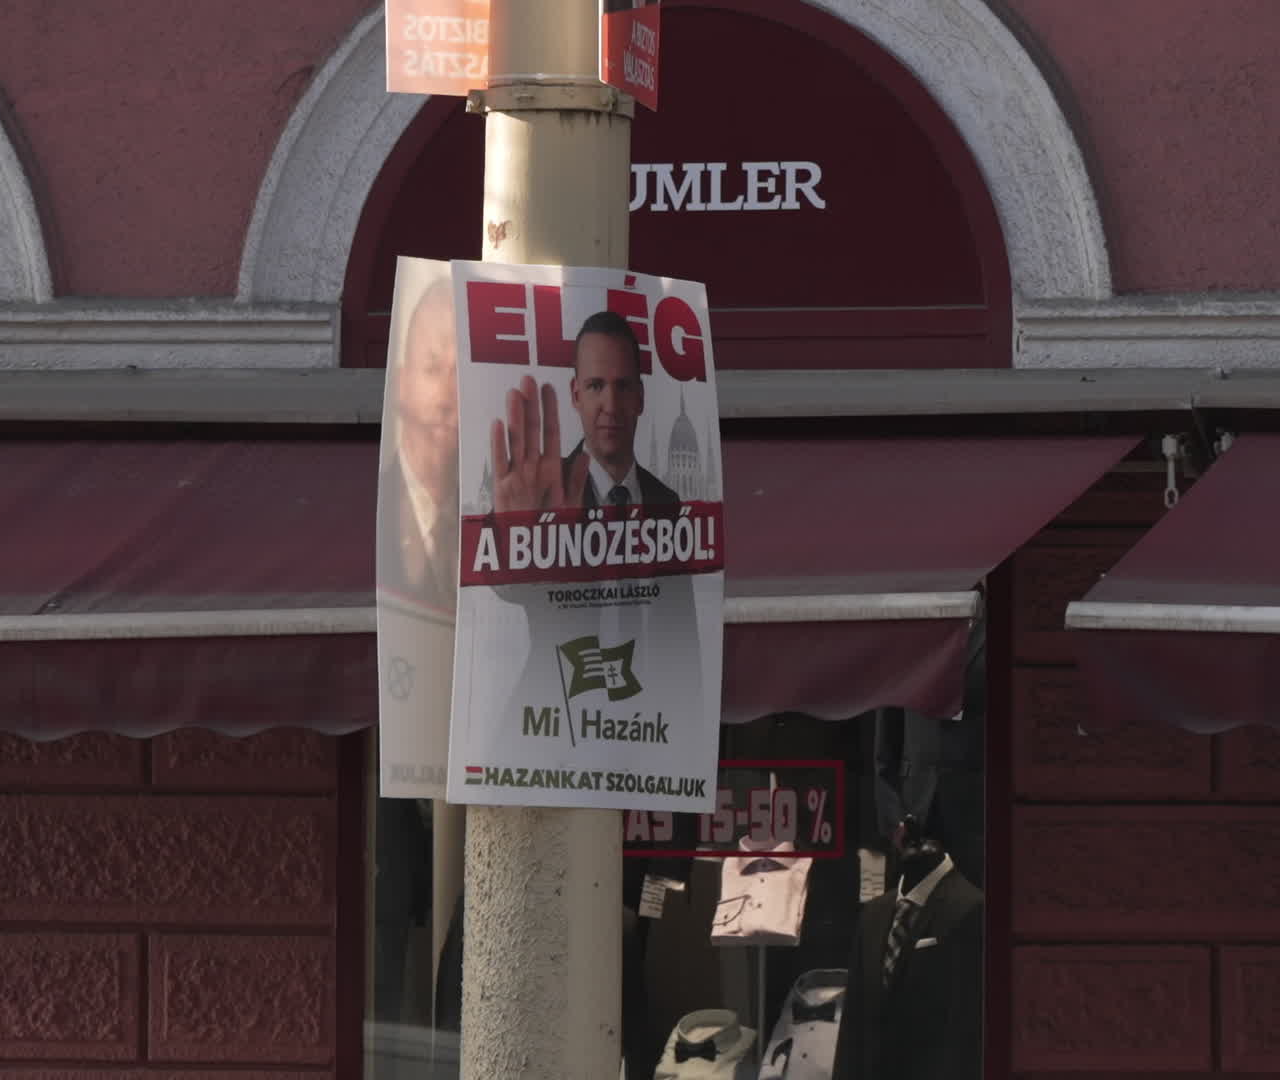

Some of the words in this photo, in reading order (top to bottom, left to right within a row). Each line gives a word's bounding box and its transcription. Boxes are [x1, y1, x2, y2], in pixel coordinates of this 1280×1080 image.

[467, 275, 707, 382] ELÉG
[473, 527, 500, 573] A
[508, 506, 715, 571] BŰNÖZÉSBŐL!
[547, 587, 619, 603] TOROCZKAI
[620, 583, 660, 600] LÁSZLÓ
[523, 706, 560, 737] Mi
[580, 708, 669, 744] Hazánk
[485, 767, 603, 792] HAZÁNKAT
[606, 770, 706, 798] SZOLGÁLJUK
[695, 786, 799, 842] 15-50
[807, 788, 833, 844] %
